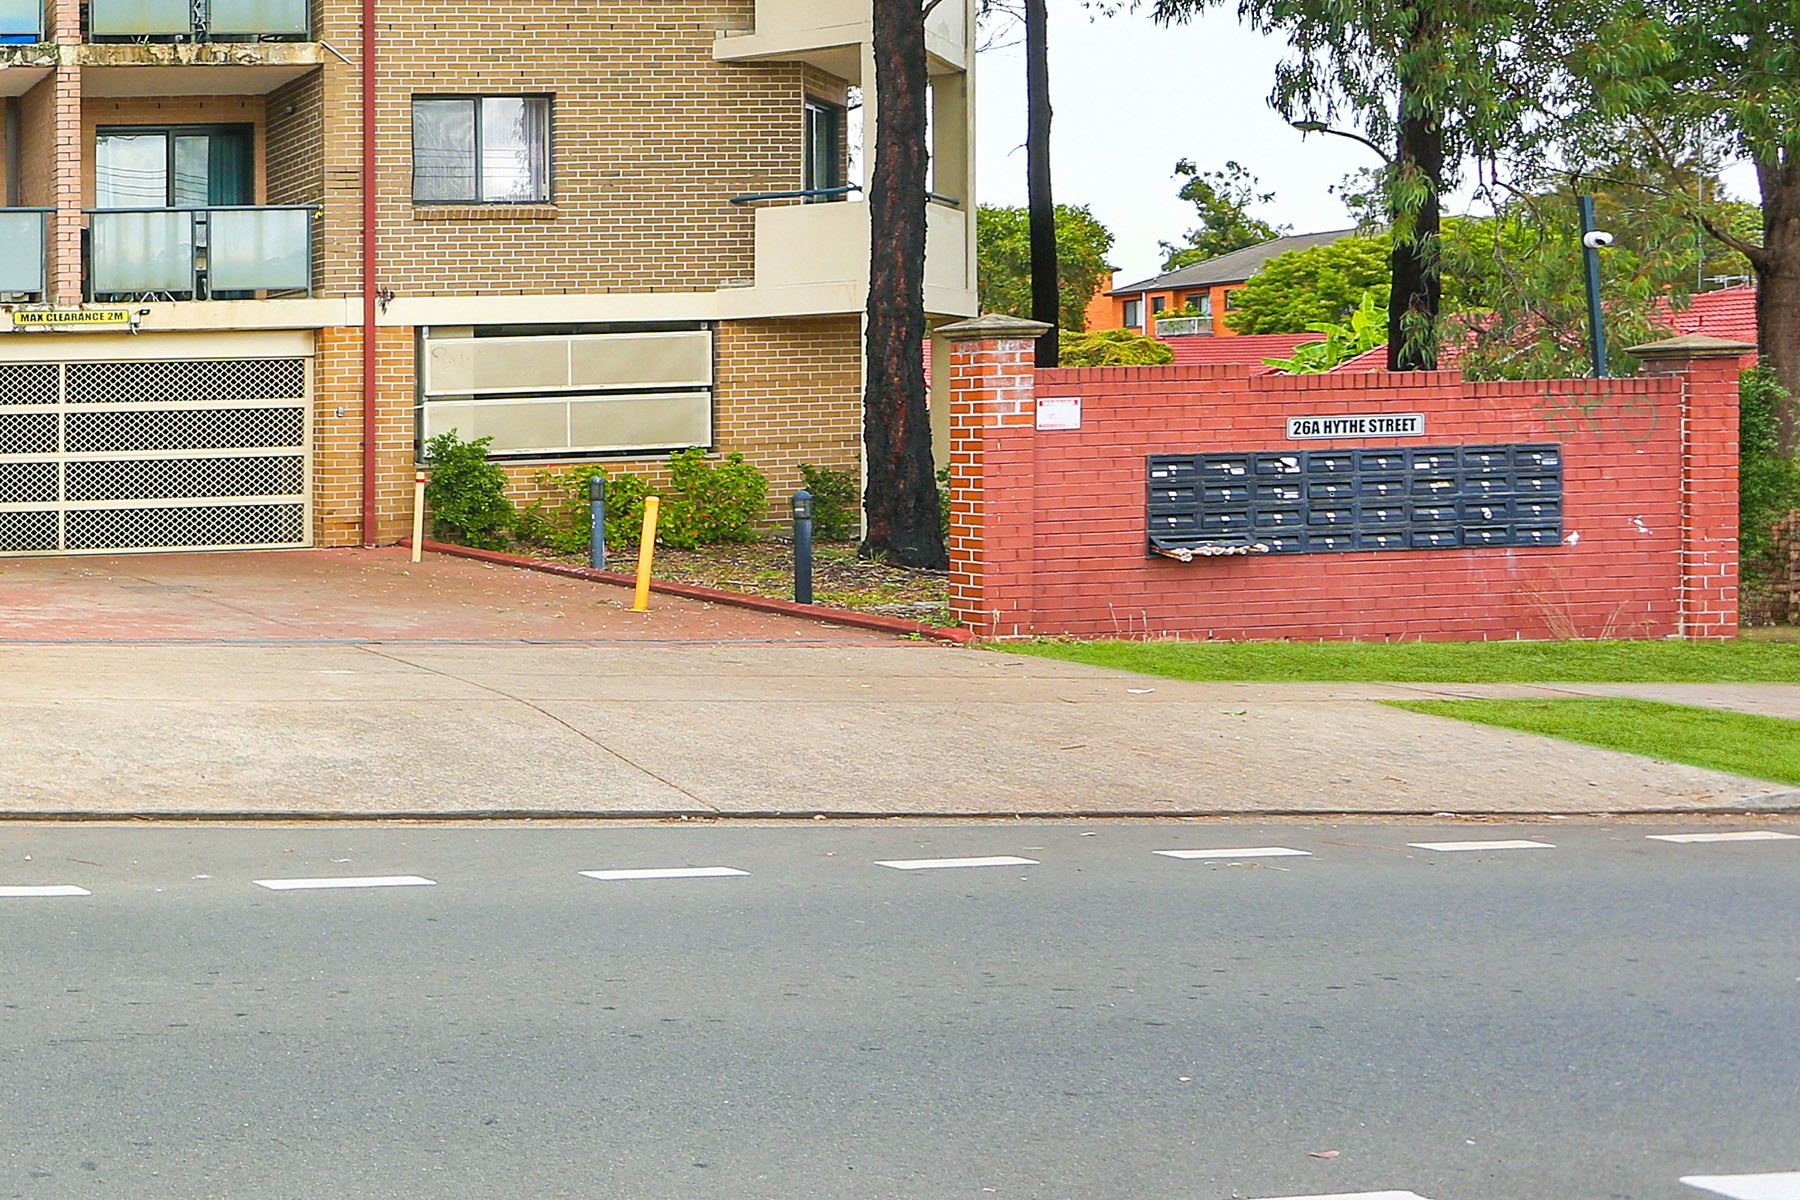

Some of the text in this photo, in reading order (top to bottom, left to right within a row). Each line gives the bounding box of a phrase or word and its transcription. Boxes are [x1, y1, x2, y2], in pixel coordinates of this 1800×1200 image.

[20, 311, 123, 322] MAX CLEARANCE 2M
[1293, 418, 1417, 435] 26A HYTHE STREET
